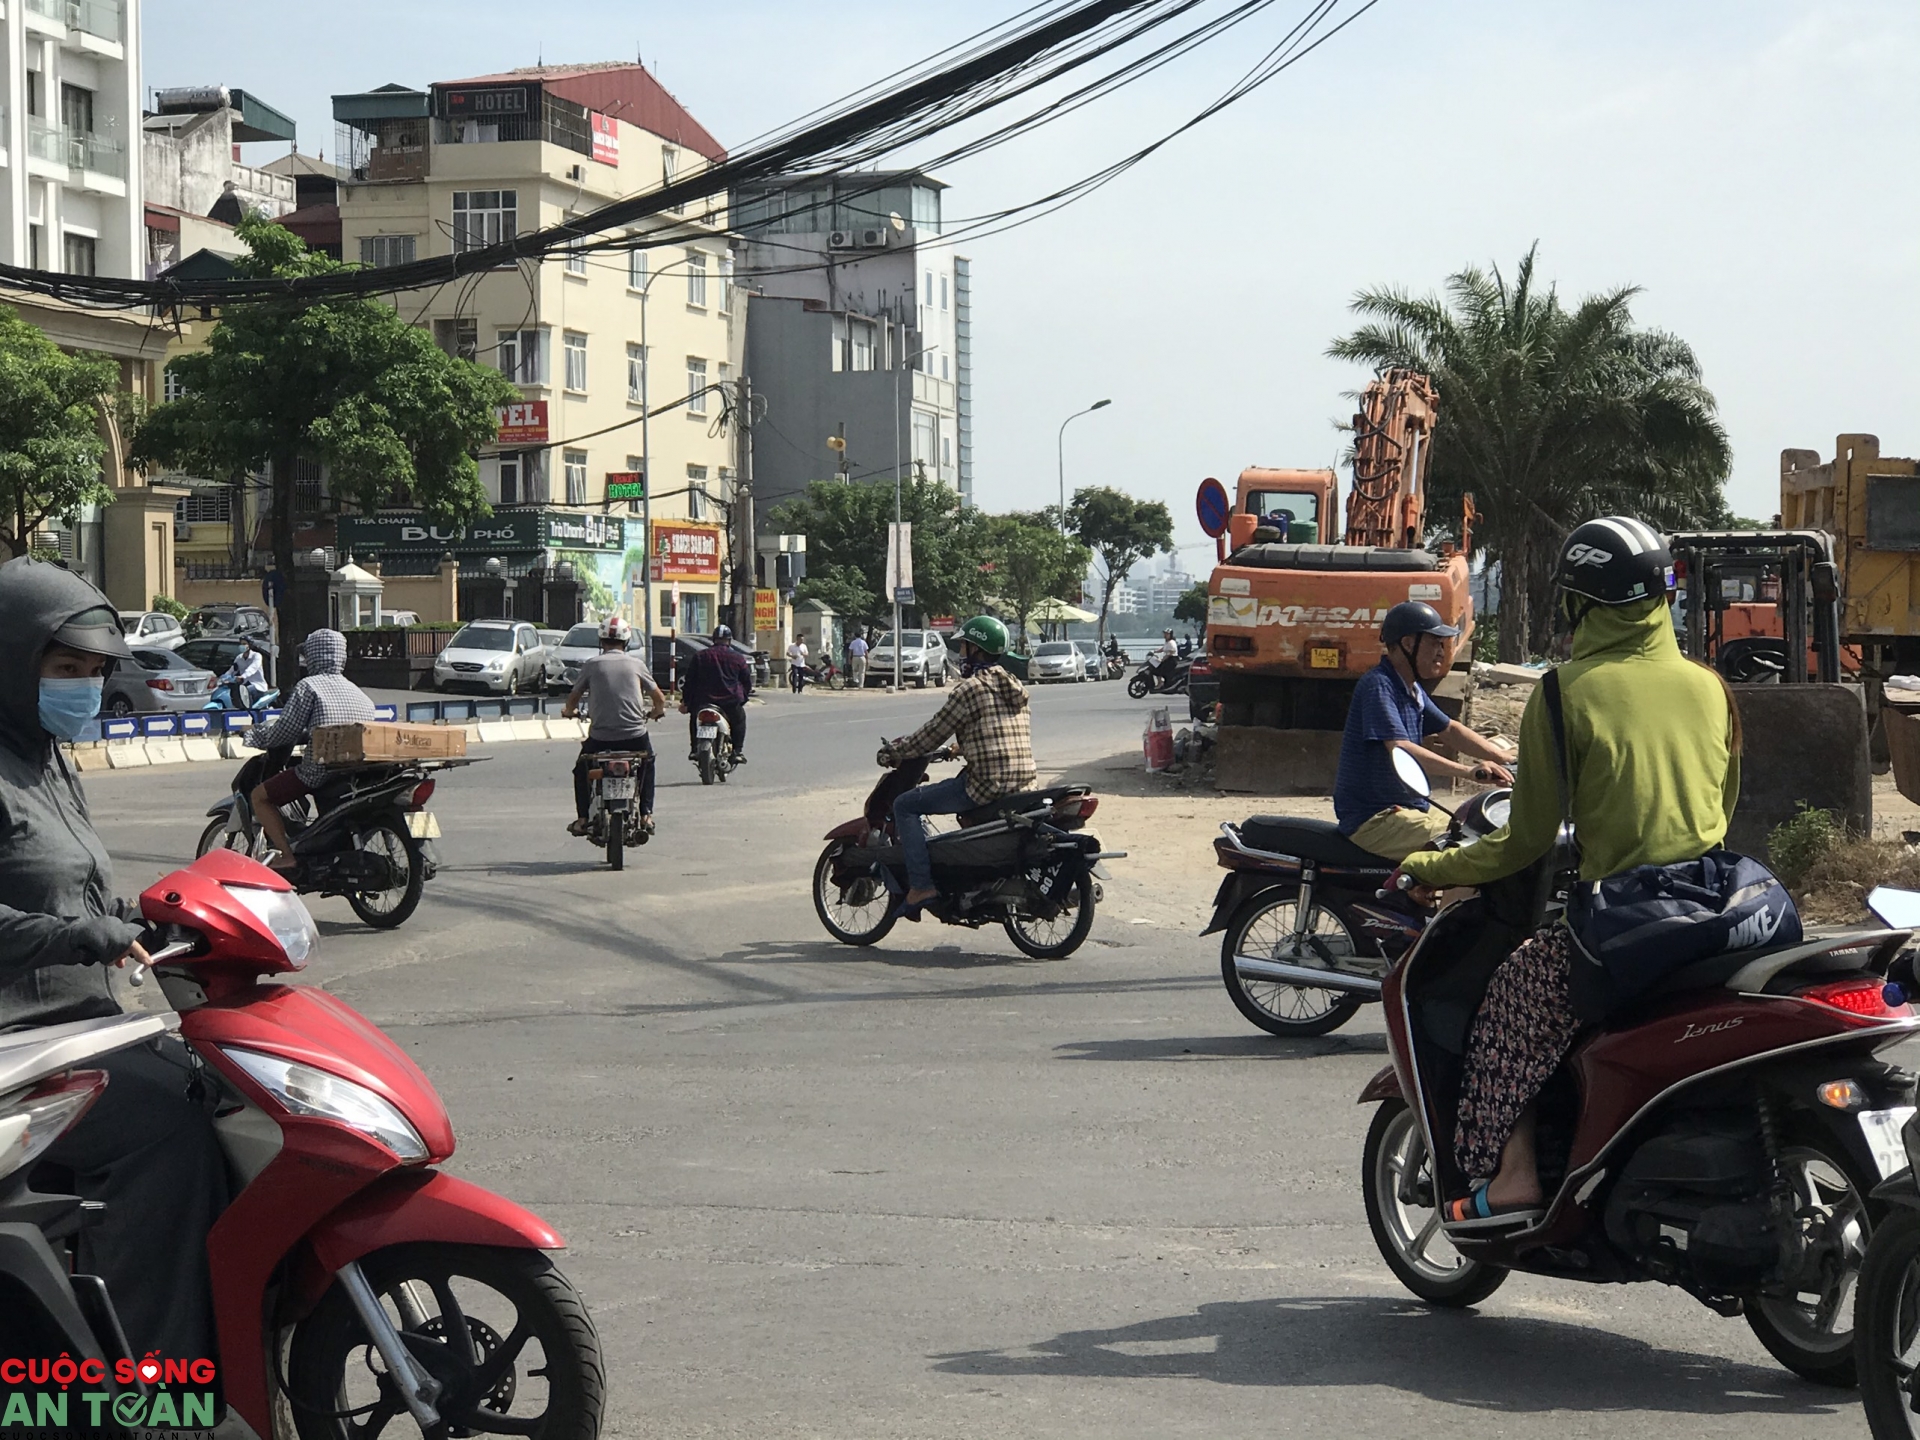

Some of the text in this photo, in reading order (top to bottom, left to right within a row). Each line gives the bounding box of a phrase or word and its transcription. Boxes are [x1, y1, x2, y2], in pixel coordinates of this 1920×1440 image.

[475, 93, 521, 110] HOTEL
[494, 404, 539, 426] TEL
[608, 482, 644, 498] HOTEL
[378, 517, 415, 525] CHANH
[474, 523, 515, 539] PHỐ
[585, 515, 605, 547] Bụi
[1565, 543, 1614, 567] GP
[968, 627, 988, 642] Grab
[1724, 903, 1773, 950] NIKE
